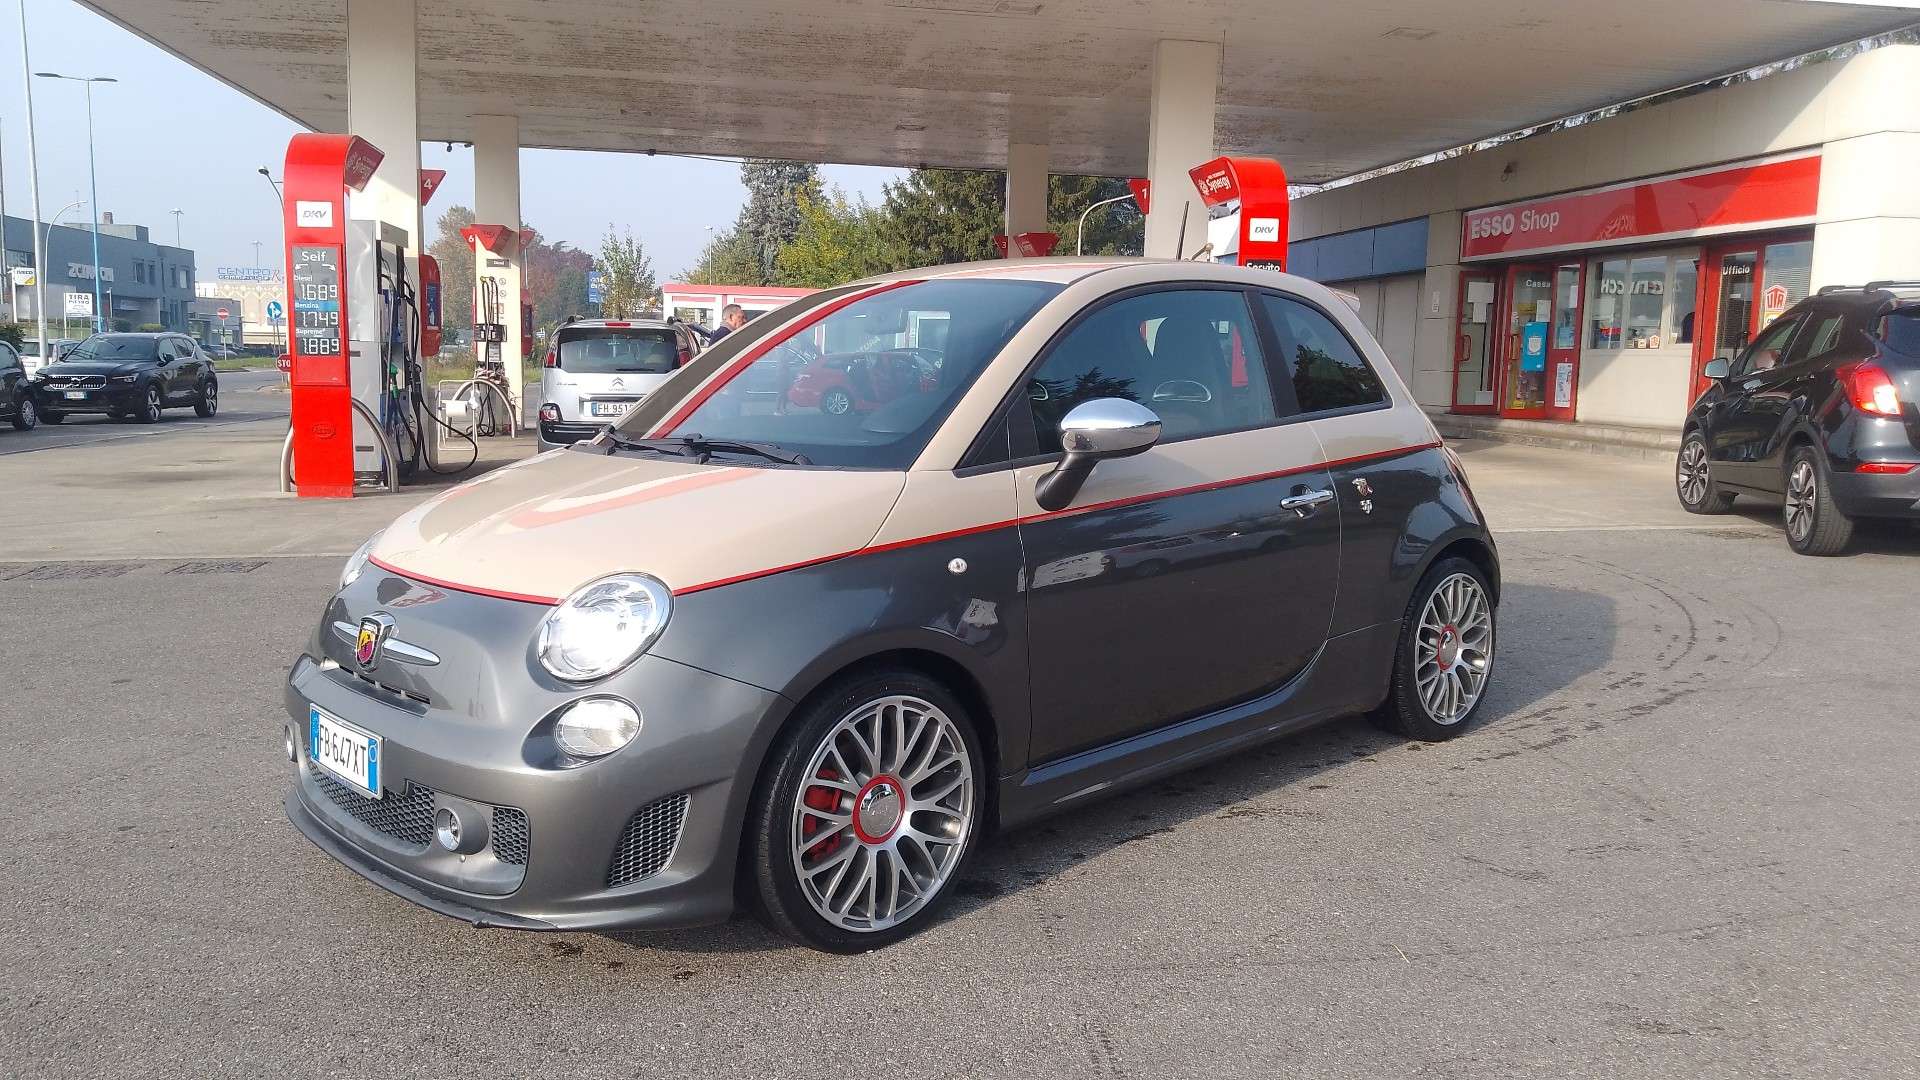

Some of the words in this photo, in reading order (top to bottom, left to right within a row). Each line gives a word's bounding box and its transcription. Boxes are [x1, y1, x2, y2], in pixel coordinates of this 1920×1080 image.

[424, 179, 433, 190] 4
[1141, 188, 1147, 199] 1
[302, 210, 327, 219] DKV
[1471, 213, 1515, 240] ESSO
[1519, 210, 1560, 232] Shop
[1254, 226, 1274, 234] DKV
[468, 234, 474, 242] 6
[1001, 241, 1007, 249] 3
[302, 251, 326, 262] Self
[217, 267, 271, 275] CENTRO
[1722, 264, 1750, 275] Ufficio
[277, 359, 291, 368] STO
